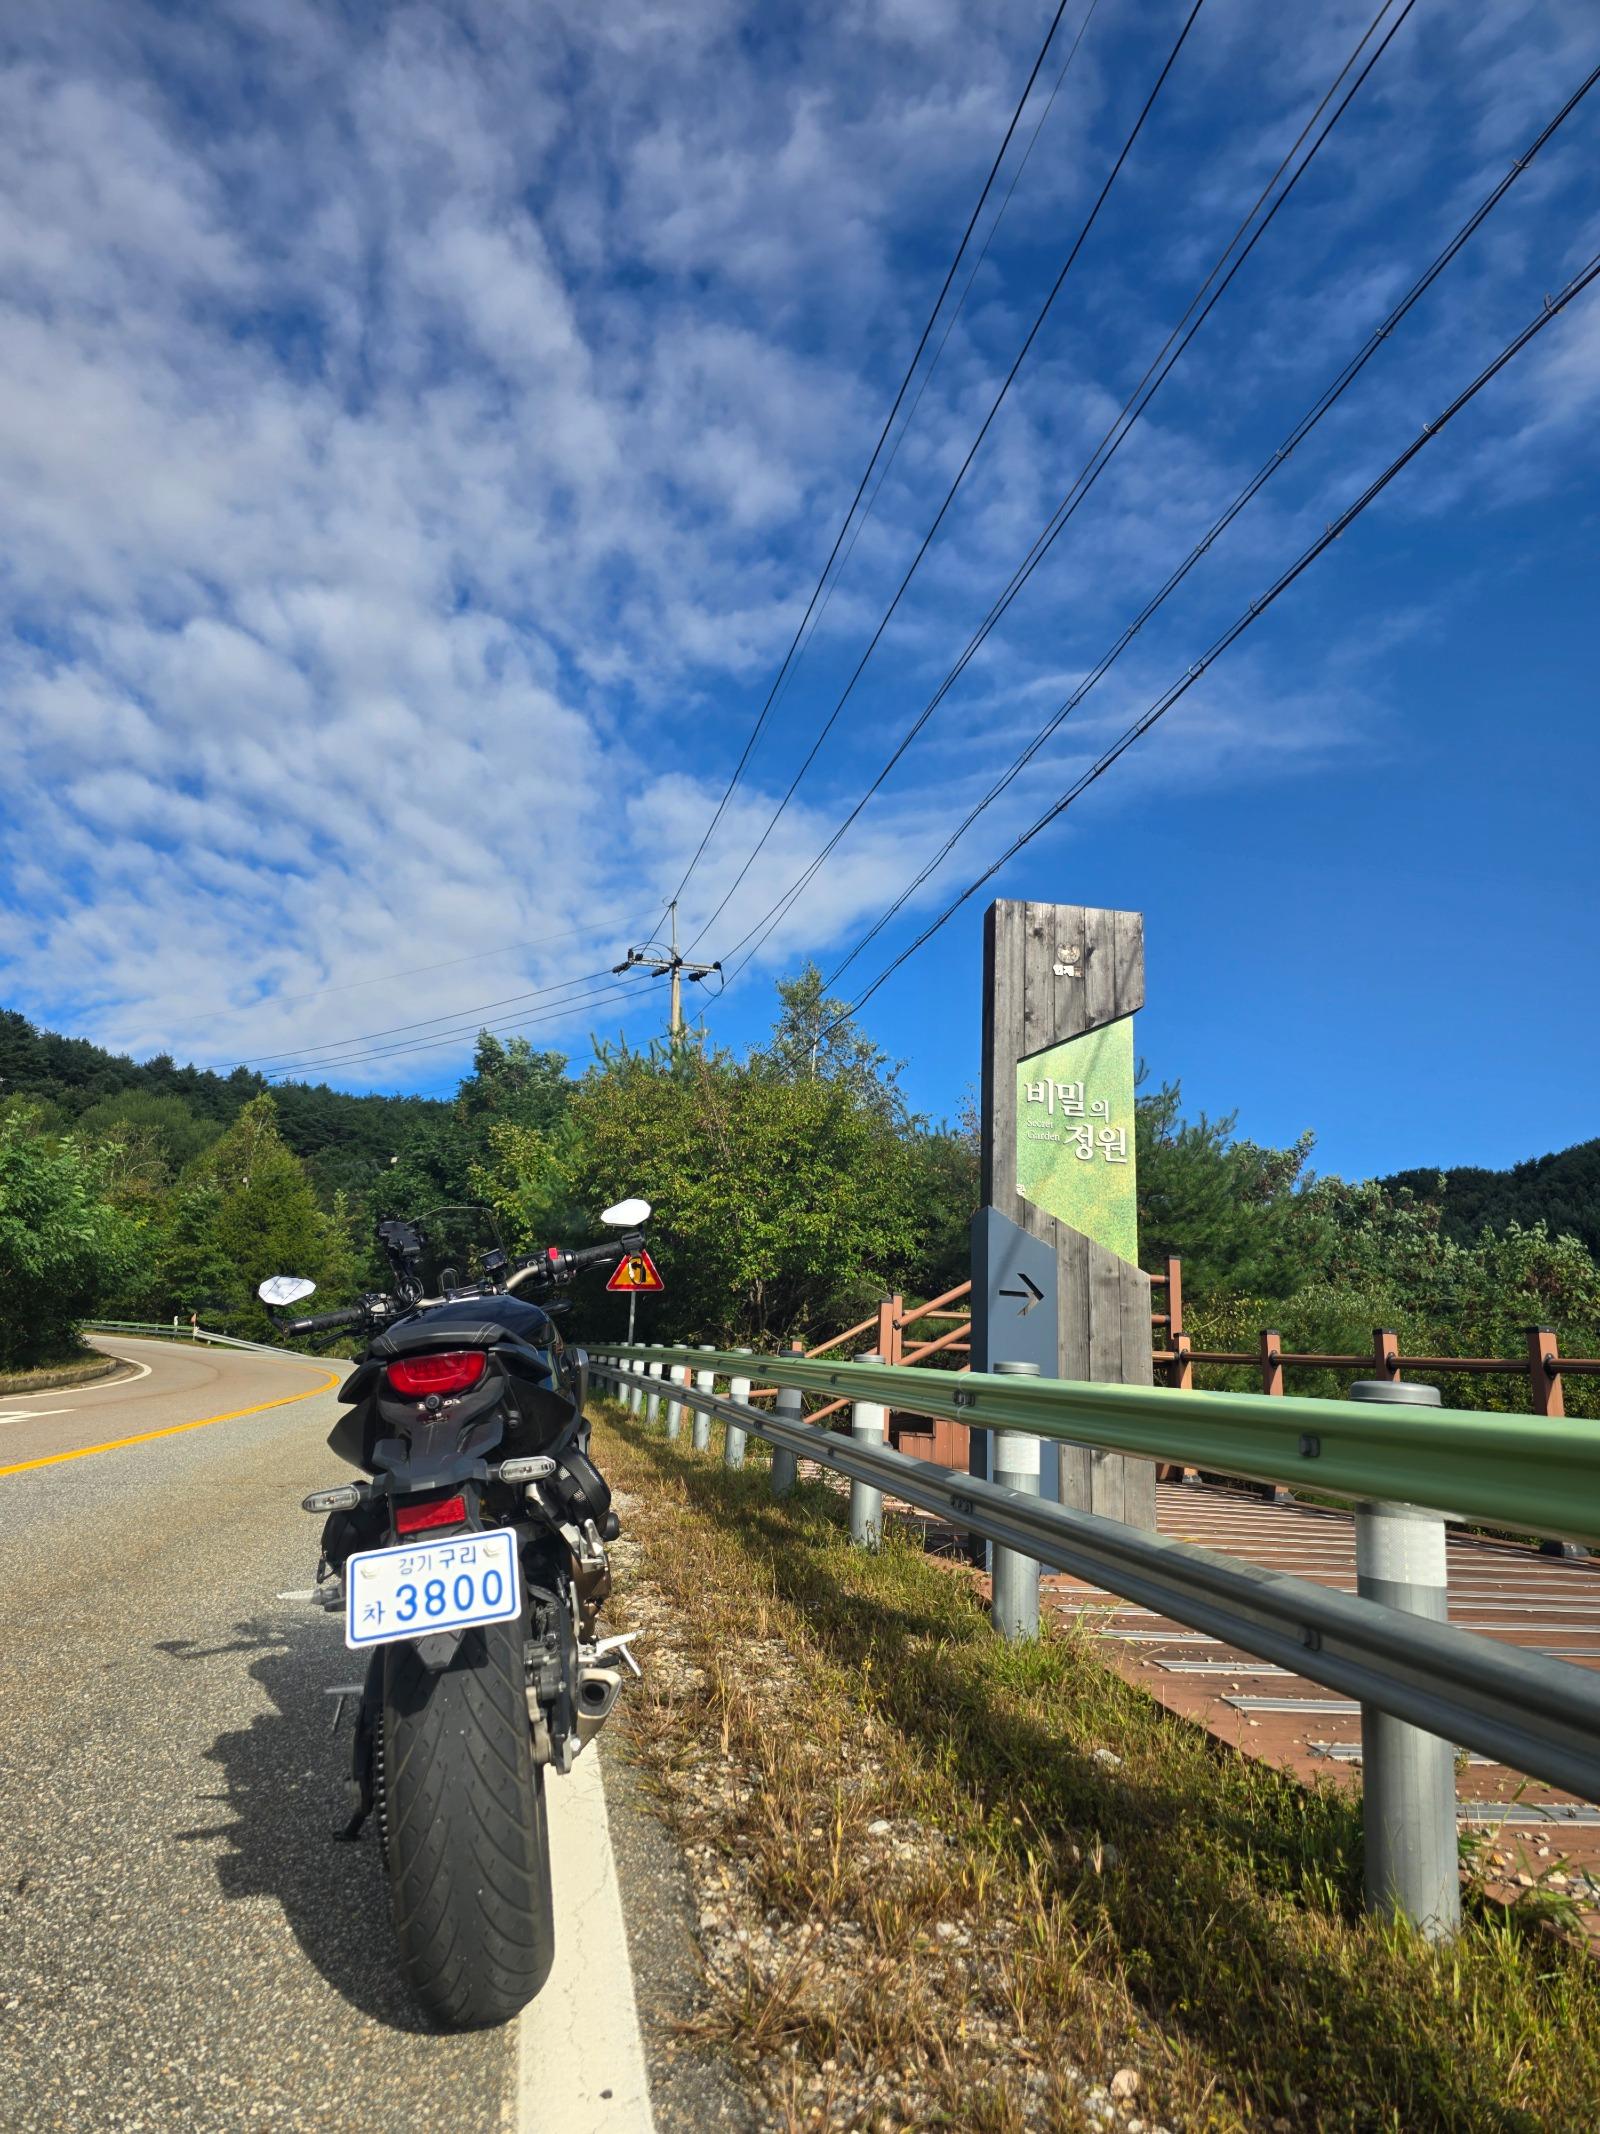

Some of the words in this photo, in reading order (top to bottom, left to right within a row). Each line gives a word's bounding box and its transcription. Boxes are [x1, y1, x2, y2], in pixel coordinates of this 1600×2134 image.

[1024, 1078, 1109, 1123] 비밀의
[1027, 1118, 1054, 1129] Secret
[1027, 1130, 1061, 1142] Garden
[1063, 1124, 1128, 1163] 정원
[439, 1545, 477, 1568] 구리
[363, 1600, 386, 1626] 차
[396, 1569, 503, 1622] 3800
